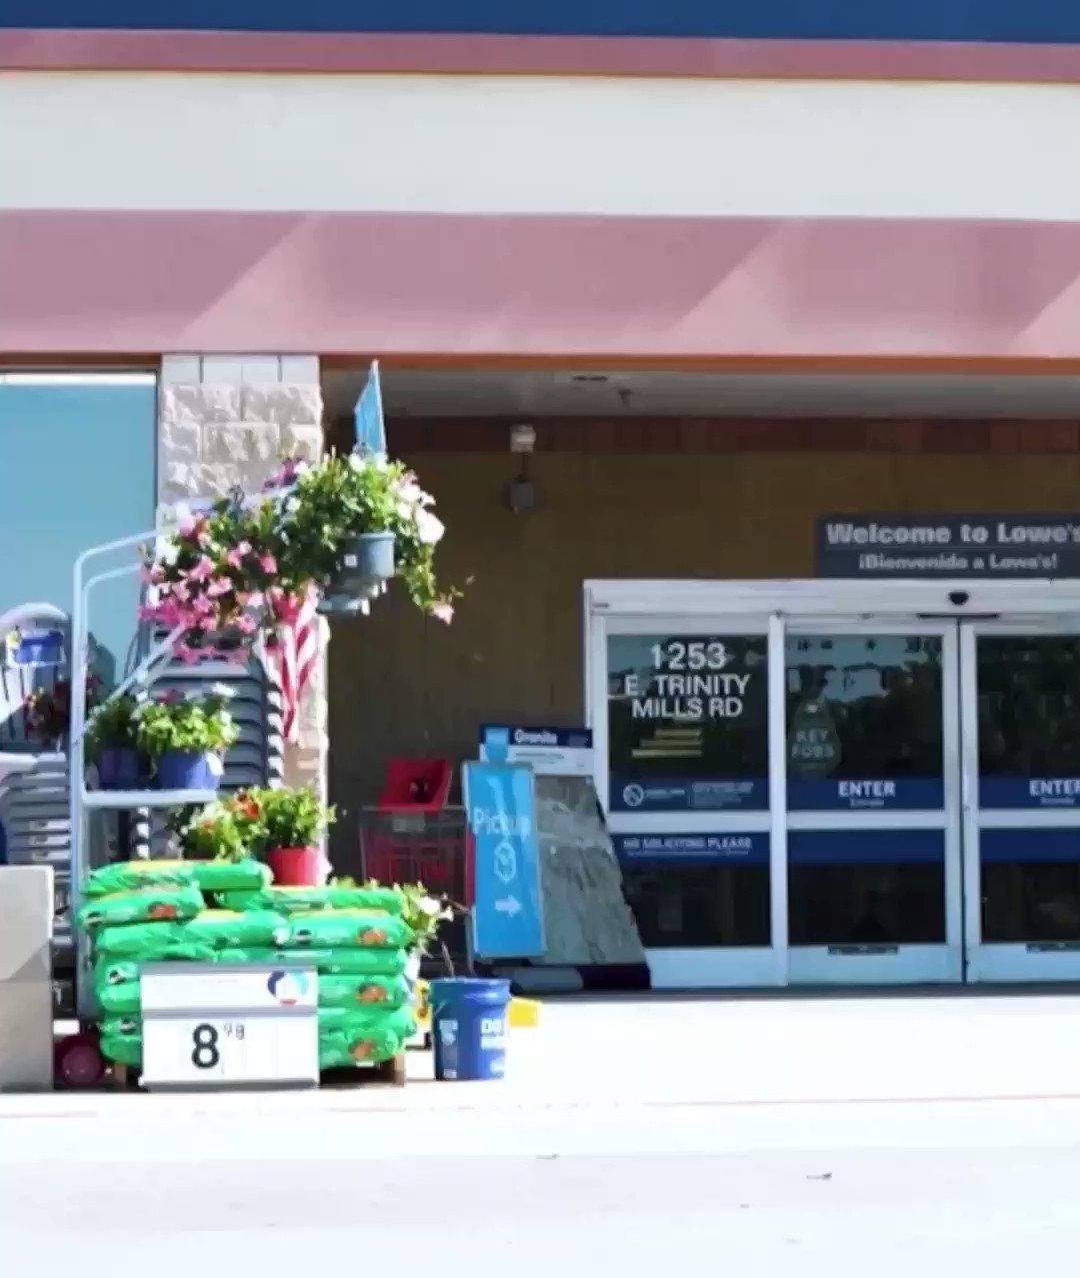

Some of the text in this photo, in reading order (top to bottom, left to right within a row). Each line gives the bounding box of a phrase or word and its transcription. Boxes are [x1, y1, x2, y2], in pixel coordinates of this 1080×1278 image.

[826, 523, 951, 544] Welcome
[960, 524, 989, 544] to
[973, 557, 985, 569] a
[651, 641, 726, 670] 1253
[624, 673, 751, 697] E. TRINITY
[631, 697, 743, 719] MILLS RD
[838, 781, 896, 798] ENTER
[191, 1023, 219, 1069] 8
